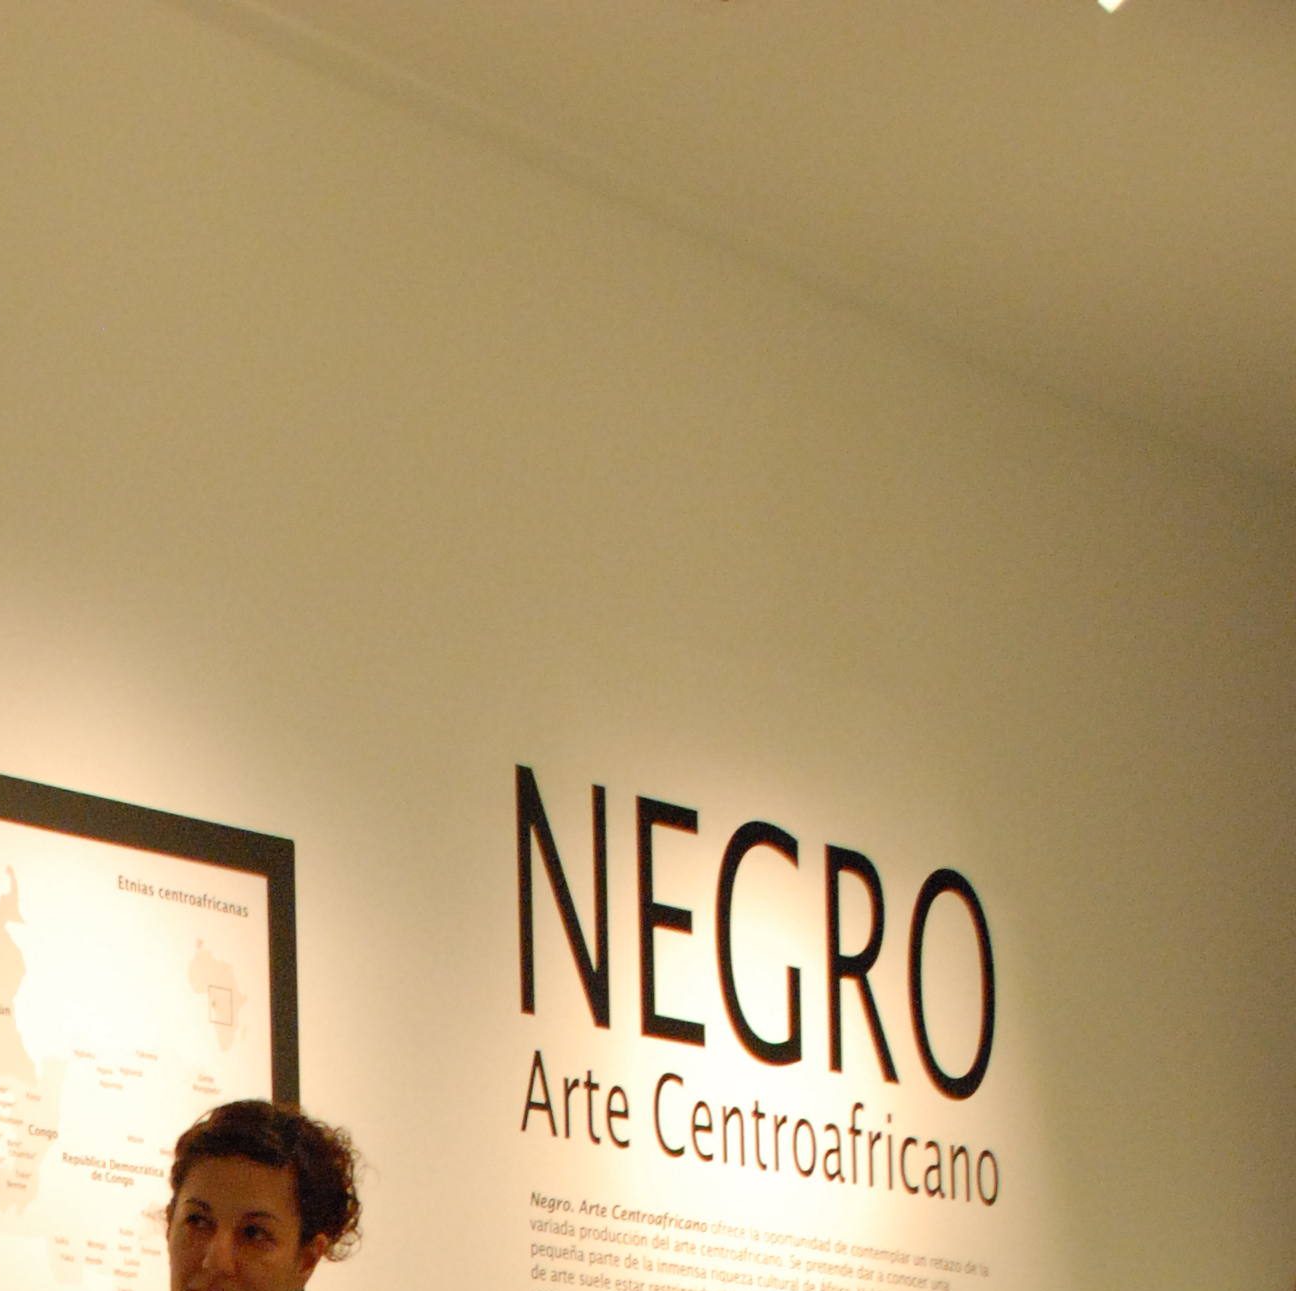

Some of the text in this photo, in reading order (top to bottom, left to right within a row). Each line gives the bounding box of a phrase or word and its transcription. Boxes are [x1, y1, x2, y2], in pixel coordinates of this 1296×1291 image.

[117, 874, 249, 918] Etnias centroafricanas
[515, 763, 996, 1101] NEGRO
[27, 1123, 59, 1141] Congo
[520, 1049, 999, 1206] Arte Centroafricano
[62, 1152, 164, 1178] República Democrática
[91, 1170, 135, 1188] de Congo
[529, 1219, 575, 1236] variada
[579, 1226, 648, 1246] producción
[651, 1234, 670, 1250] del
[673, 1240, 696, 1254] arte
[530, 1191, 574, 1213] Negro.
[578, 1199, 607, 1218] Arte
[611, 1203, 708, 1232] Centroafricano
[710, 1219, 746, 1238] ofrece
[750, 1225, 760, 1241] la
[763, 1231, 831, 1252] oportunidad
[530, 1243, 584, 1262] pequeña
[589, 1251, 620, 1267] parte
[623, 1253, 640, 1269] de
[642, 1255, 653, 1271] la
[657, 1261, 707, 1278] inmensa
[710, 1269, 753, 1285] riqueza
[756, 1274, 799, 1291] cultural
[530, 1263, 546, 1281] de
[550, 1270, 575, 1284] arte
[579, 1273, 611, 1289] suele
